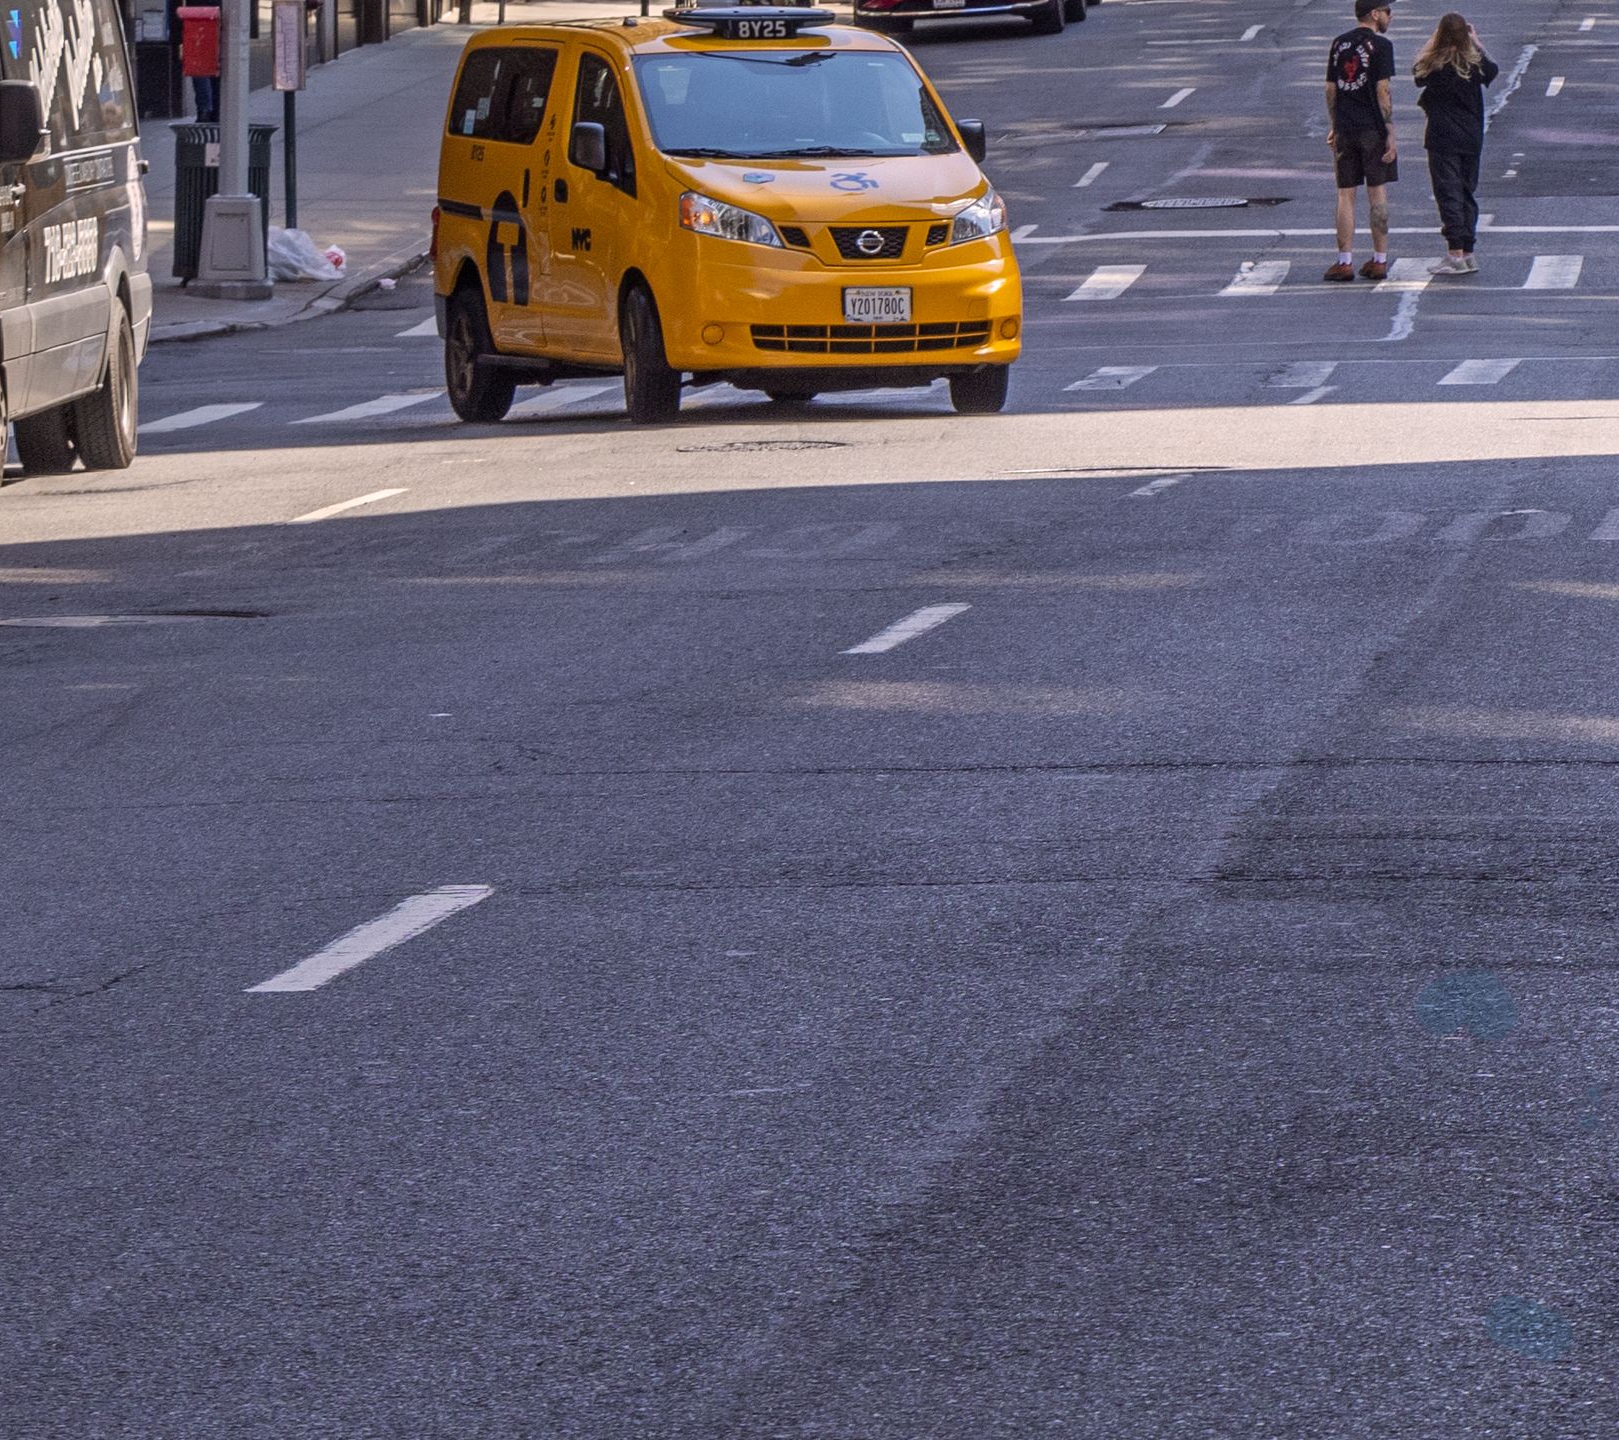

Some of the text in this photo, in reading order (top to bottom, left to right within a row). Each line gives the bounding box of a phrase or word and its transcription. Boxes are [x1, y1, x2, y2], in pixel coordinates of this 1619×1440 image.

[738, 20, 787, 38] 8Y25
[571, 227, 592, 252] NYC
[850, 297, 904, 316] Y201780C
